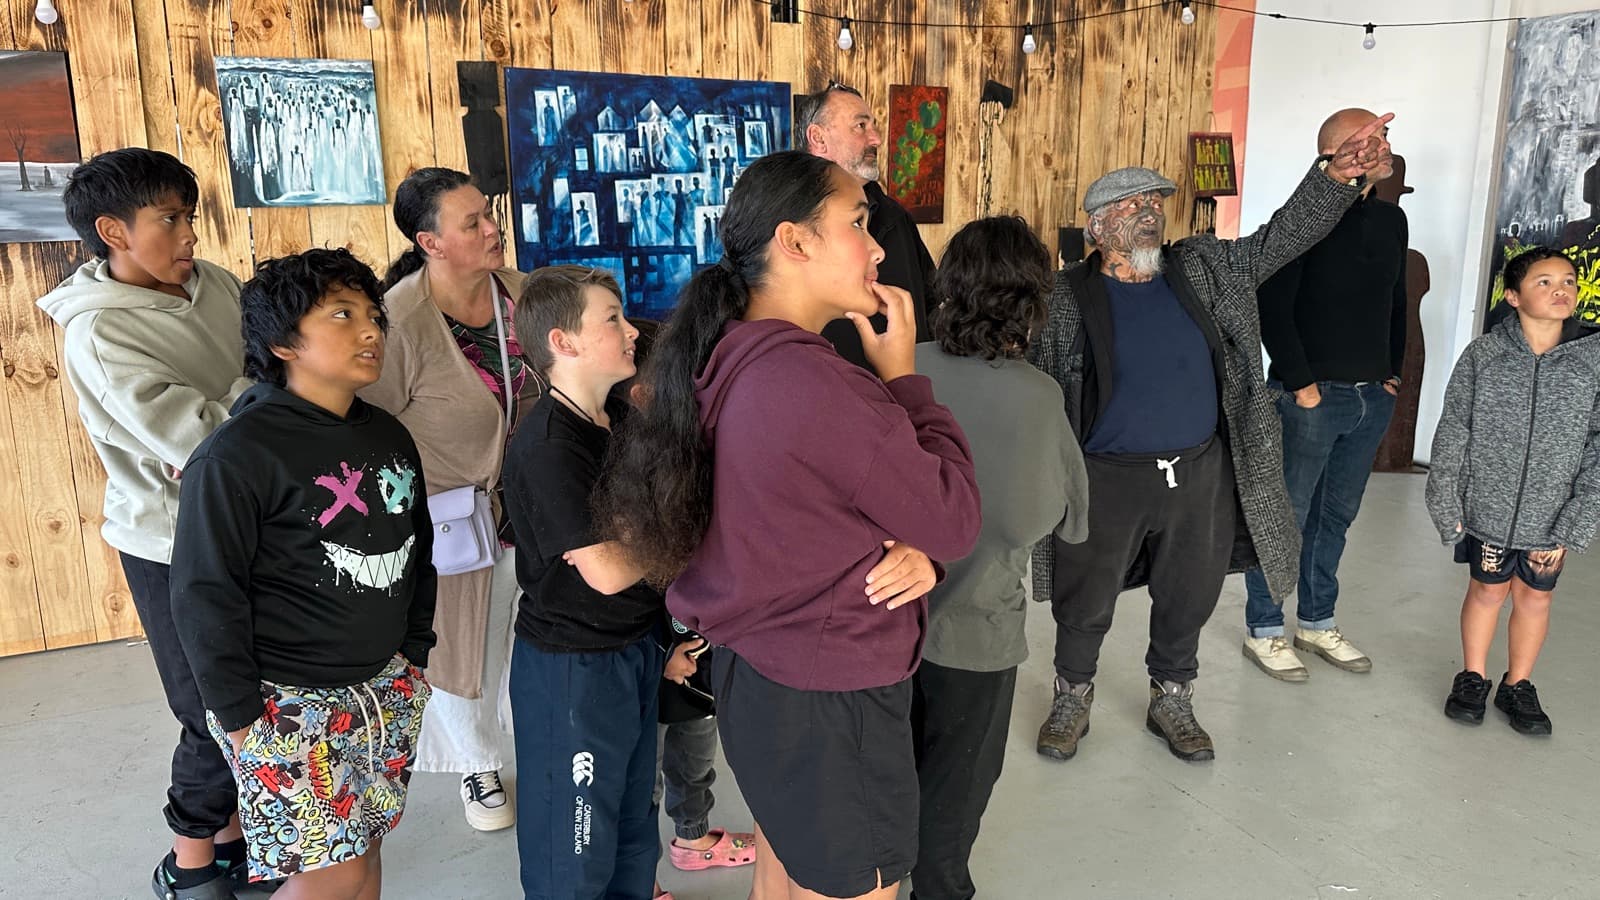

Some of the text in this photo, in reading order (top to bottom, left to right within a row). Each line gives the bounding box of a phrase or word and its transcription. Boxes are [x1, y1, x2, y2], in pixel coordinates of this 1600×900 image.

[1481, 542, 1504, 573] ing
[575, 795, 583, 855] OF NEW ZEALAND
[584, 804, 592, 845] CANTERBURY
